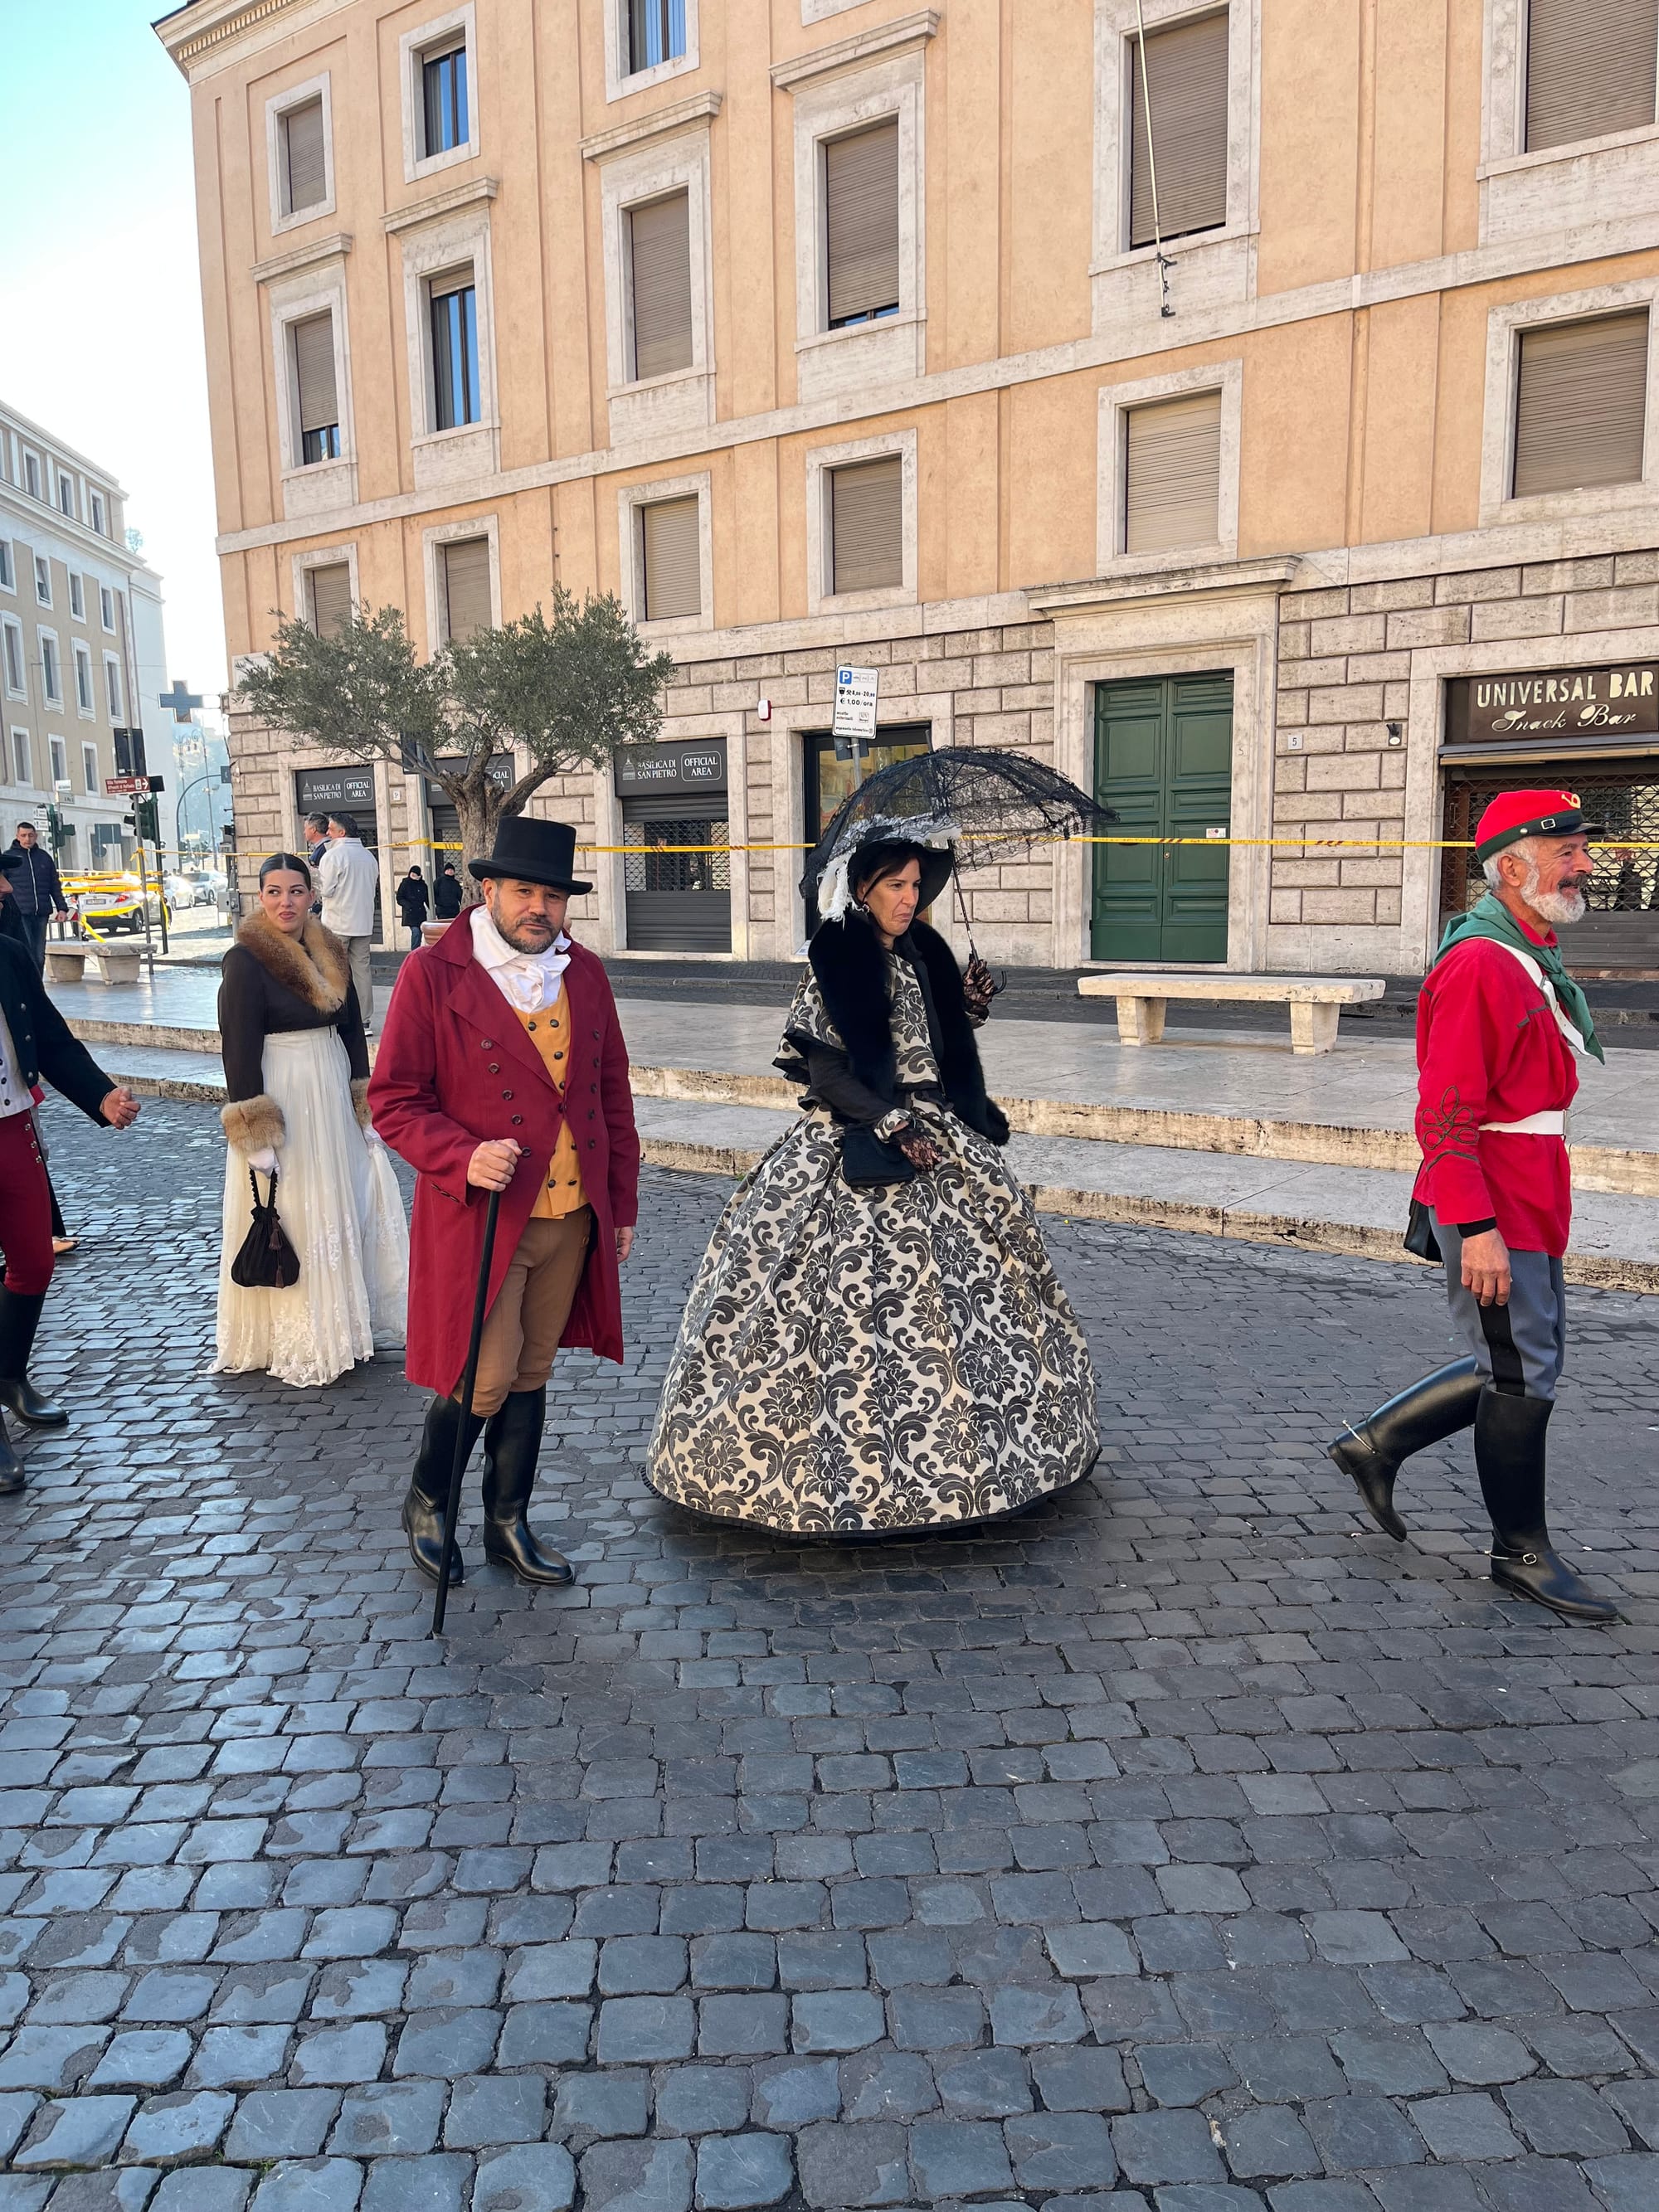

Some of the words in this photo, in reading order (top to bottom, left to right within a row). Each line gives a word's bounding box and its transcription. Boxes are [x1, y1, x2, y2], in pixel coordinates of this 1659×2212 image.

[1477, 675, 1597, 708] UNIVERSAL
[1608, 670, 1654, 698] BAR
[1491, 709, 1567, 732] Snack
[1576, 703, 1637, 727] Bar
[1292, 737, 1297, 746] 5
[669, 759, 677, 768] DI
[684, 756, 718, 767] OFFICIAL
[637, 771, 651, 780] SAN
[652, 769, 678, 779] PIETRO
[691, 767, 713, 776] AREA
[313, 784, 335, 792] BASILICA
[346, 780, 371, 790] OFFICIAL
[313, 792, 324, 800] SAN
[324, 791, 342, 800] PIETRO
[351, 790, 367, 798] AREA
